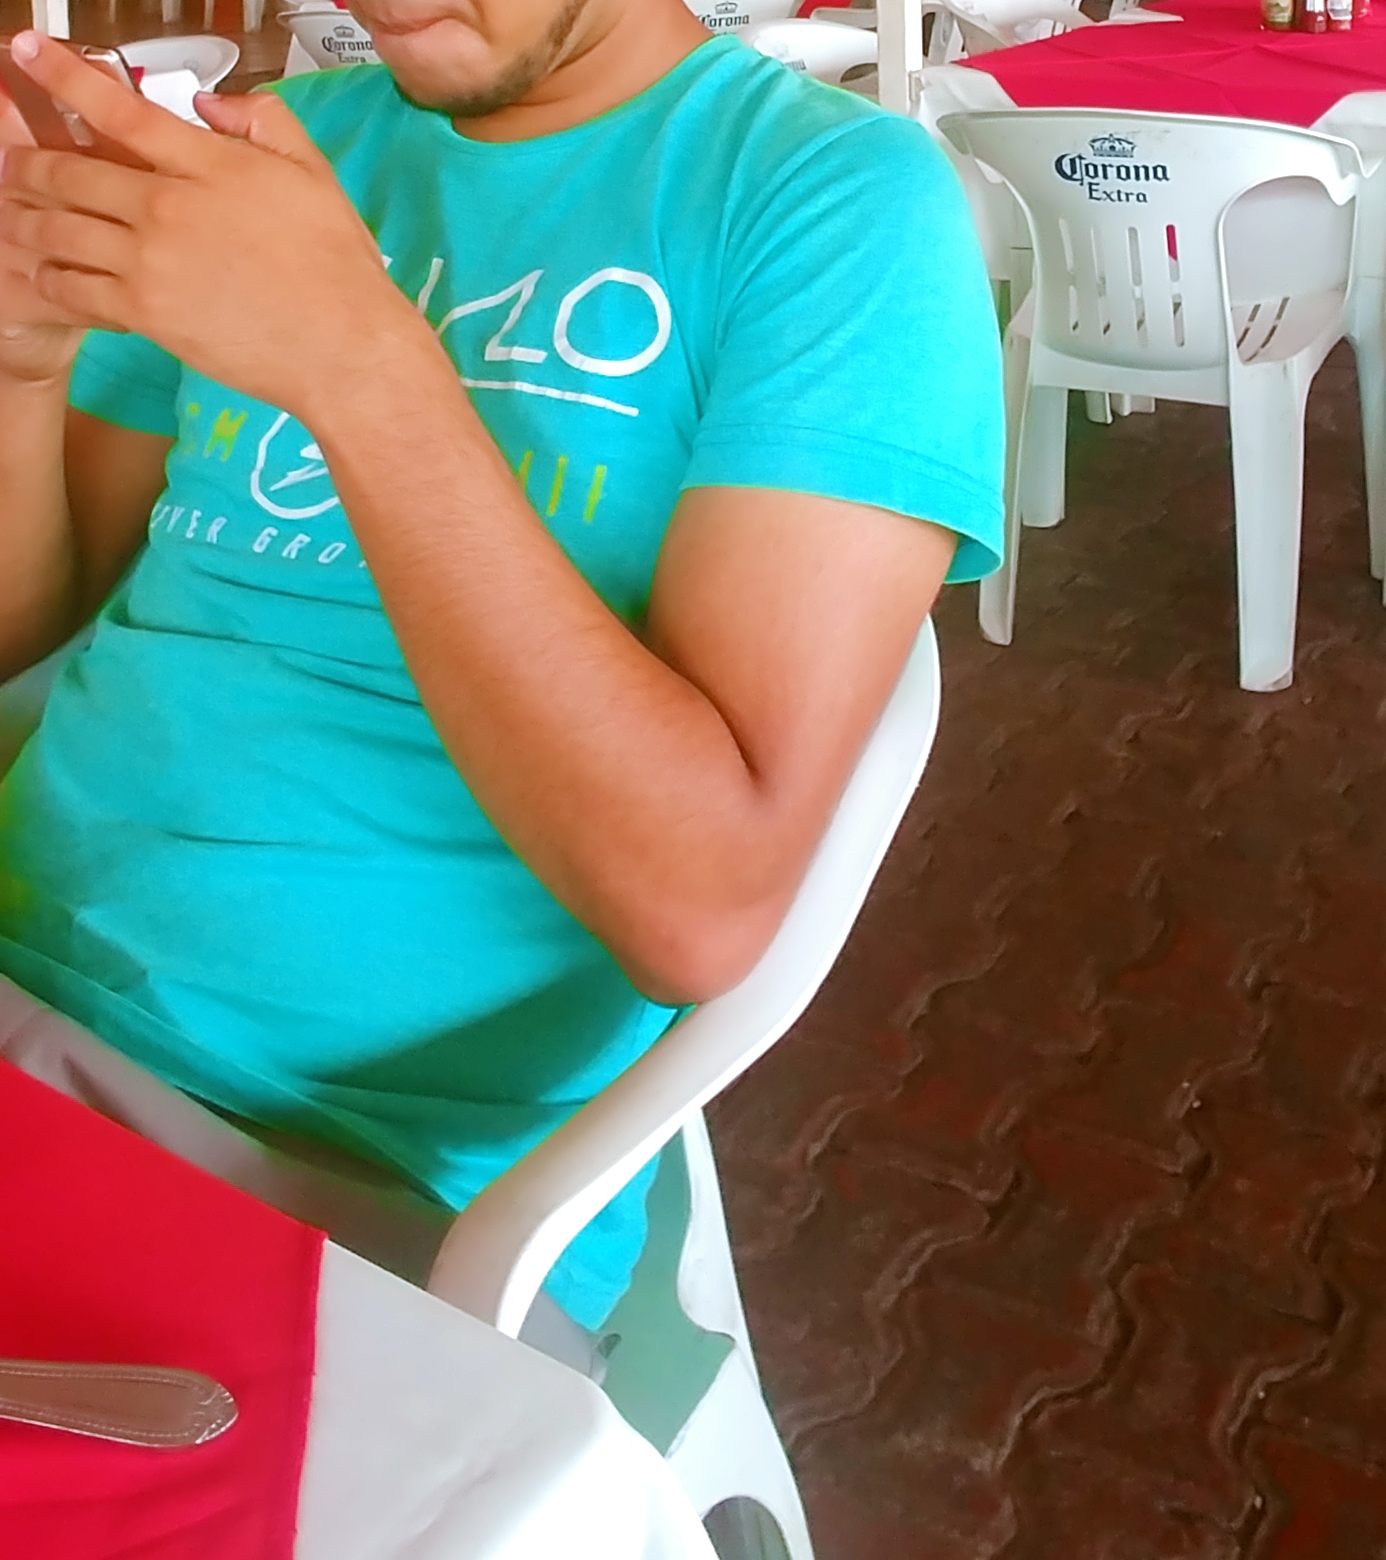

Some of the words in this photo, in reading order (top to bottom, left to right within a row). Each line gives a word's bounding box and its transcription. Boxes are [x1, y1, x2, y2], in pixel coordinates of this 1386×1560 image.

[1054, 153, 1171, 186] Corona
[1087, 182, 1149, 203] Extra
[251, 525, 366, 567] GRO
